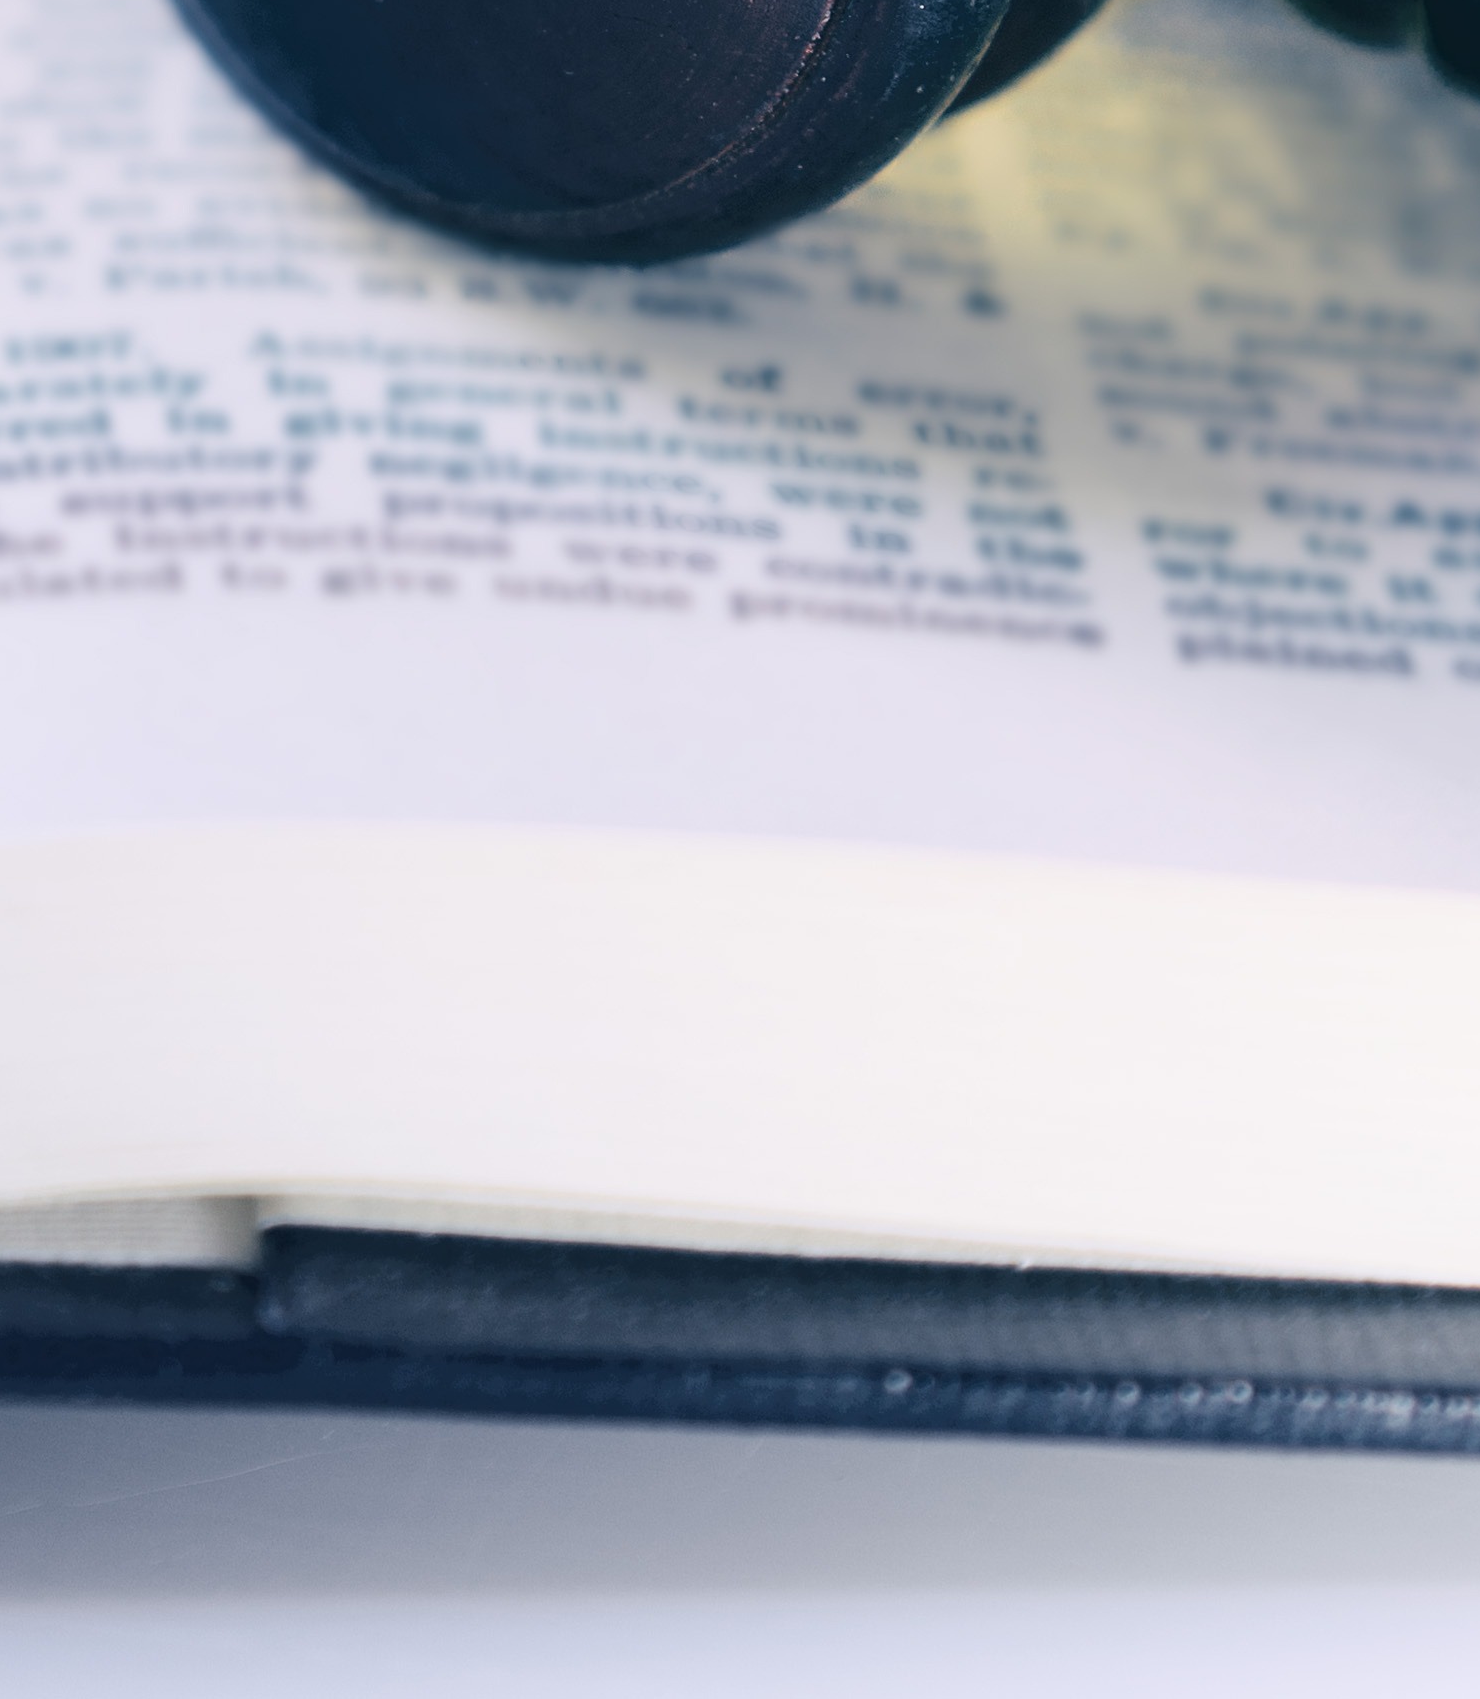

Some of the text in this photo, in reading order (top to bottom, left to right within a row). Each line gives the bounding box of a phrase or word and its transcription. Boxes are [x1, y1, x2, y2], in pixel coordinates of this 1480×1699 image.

[249, 327, 648, 383] Assignments
[718, 362, 782, 393] of
[857, 378, 1038, 429] error,
[265, 367, 329, 398] in
[386, 380, 623, 417] general
[678, 392, 862, 440] terms
[911, 417, 1044, 457] that
[166, 404, 231, 435] in
[284, 404, 482, 448] giving
[538, 414, 924, 482] instructions
[60, 484, 309, 518] support
[383, 491, 783, 541] propositions
[848, 523, 913, 555] in
[977, 535, 1087, 574] the
[368, 452, 725, 505] negligence,
[769, 483, 926, 517] were
[968, 501, 1069, 533] not
[114, 524, 513, 559] instructions
[561, 541, 720, 574] were
[763, 555, 1092, 607] contradic-
[1140, 517, 1235, 549] ror
[1304, 531, 1369, 562] to
[1154, 557, 1350, 595] where
[1386, 573, 1435, 603] it
[219, 559, 287, 589] to
[321, 561, 459, 599] give
[491, 575, 694, 612] undue
[729, 591, 1109, 653] prominence
[1176, 634, 1415, 678] plained
